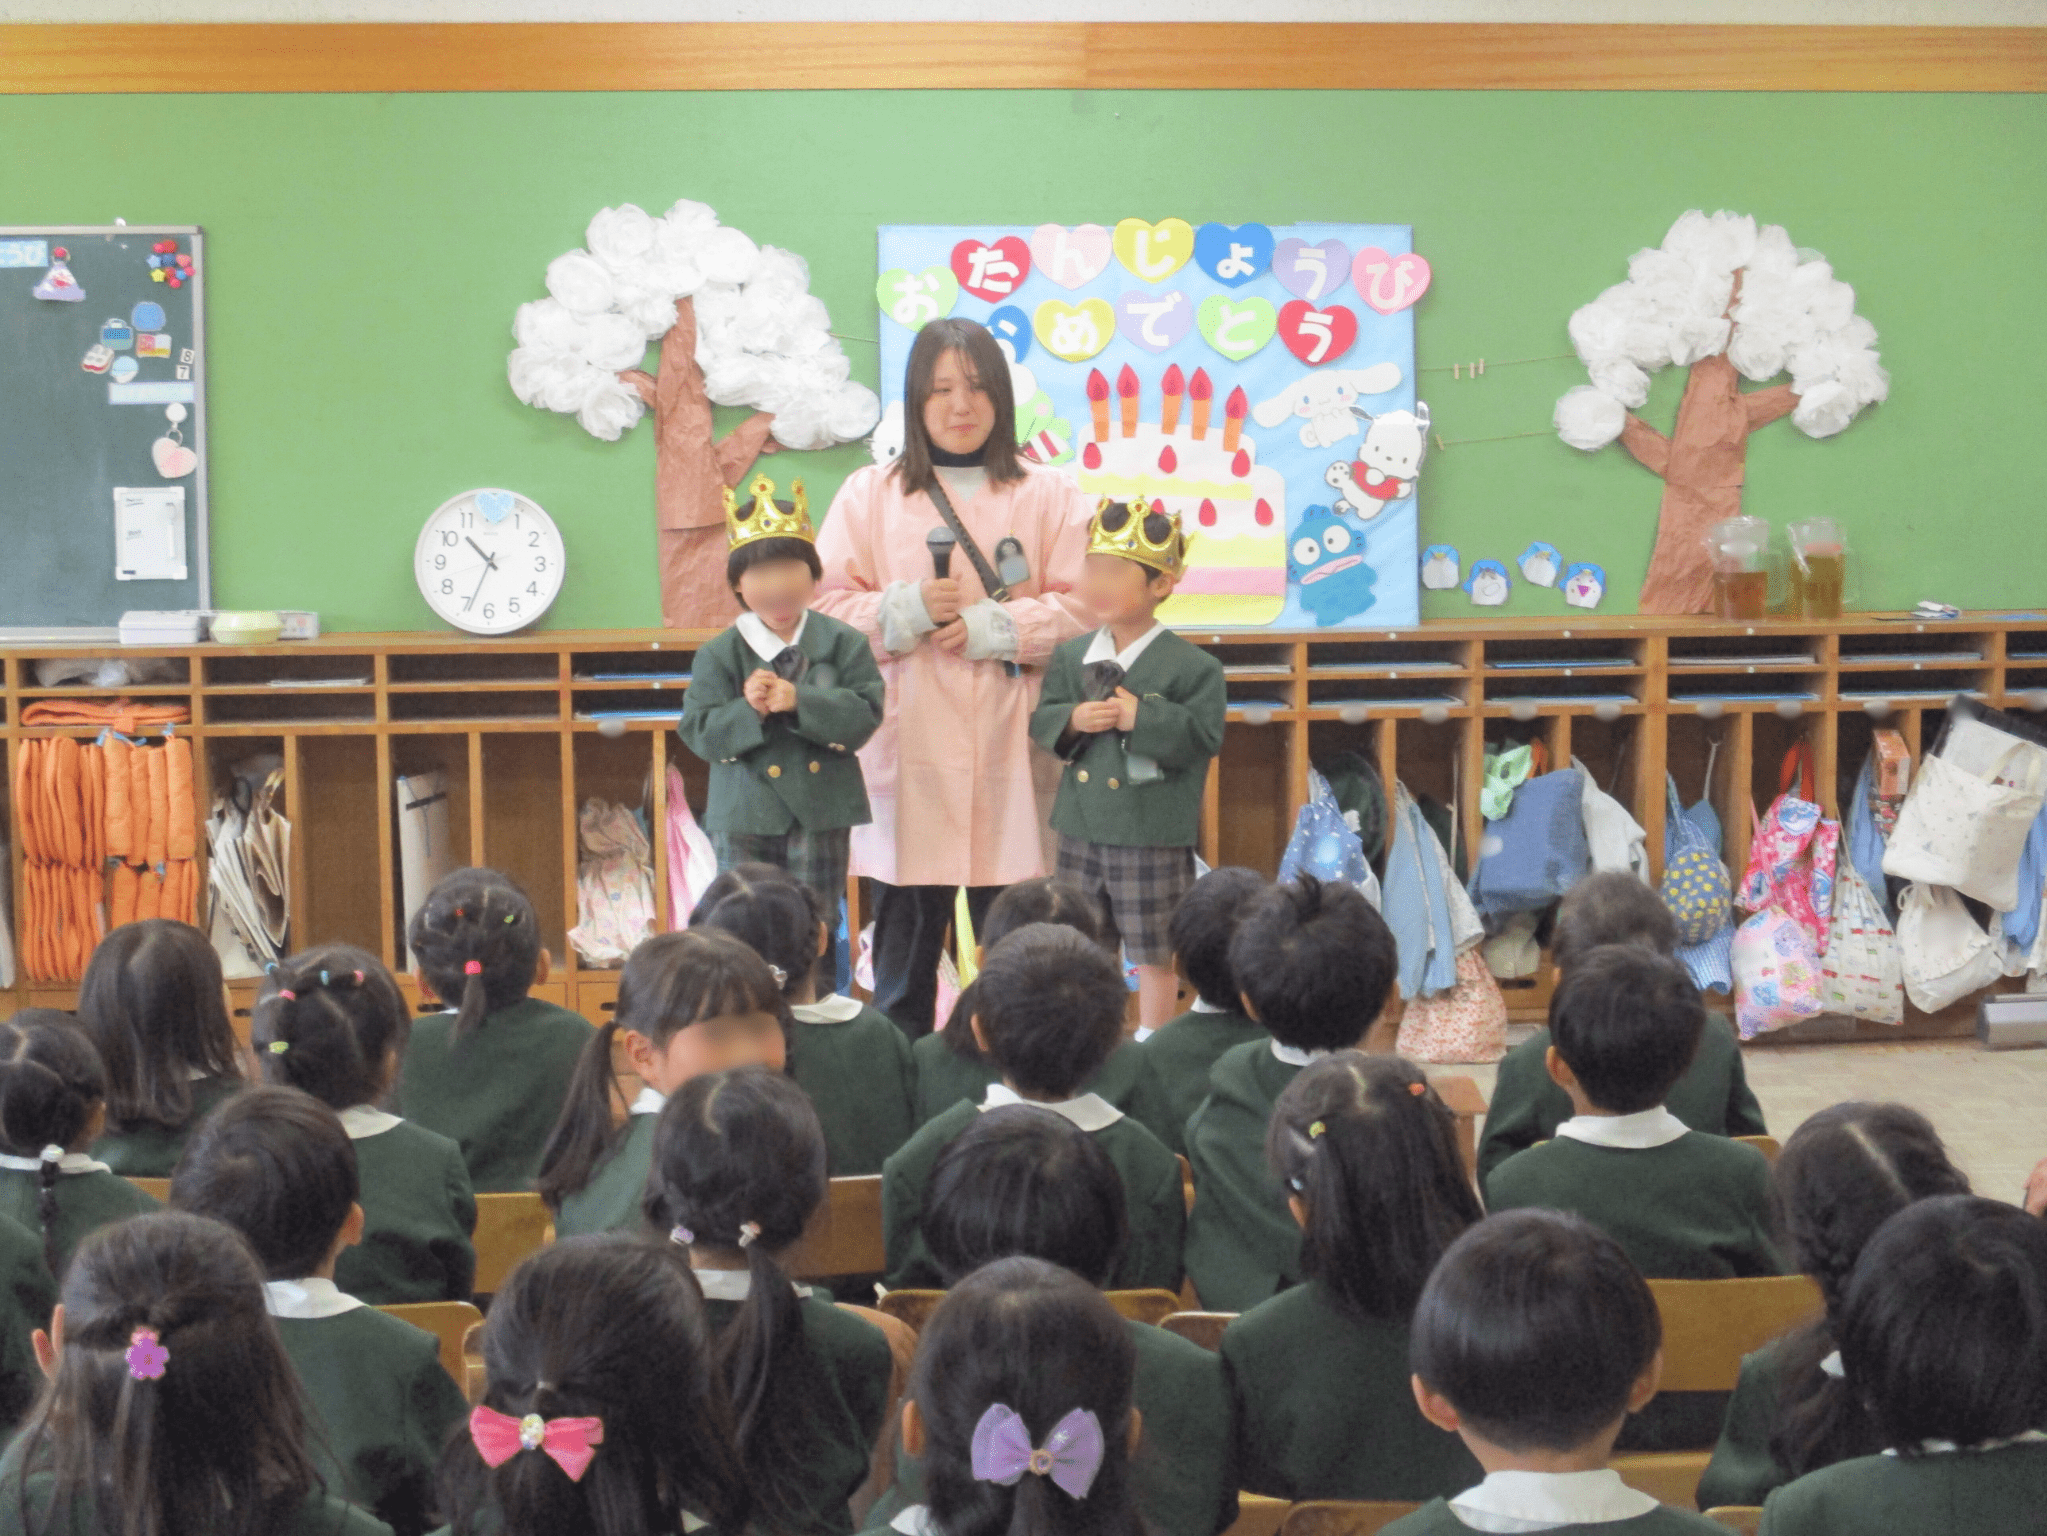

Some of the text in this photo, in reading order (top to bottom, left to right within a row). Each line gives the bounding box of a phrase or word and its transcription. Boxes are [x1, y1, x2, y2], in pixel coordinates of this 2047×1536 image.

[893, 230, 1415, 324] おたんじょうび
[180, 367, 187, 378] 7
[461, 512, 473, 528] 11
[514, 513, 520, 530] 1
[441, 530, 458, 547] 10
[528, 531, 540, 547] 2
[434, 554, 447, 570] 9
[534, 556, 546, 572] 3
[441, 578, 454, 594] 8
[526, 581, 538, 596] 4
[460, 596, 471, 612] 7
[483, 603, 495, 619] 6
[509, 597, 520, 613] 5
